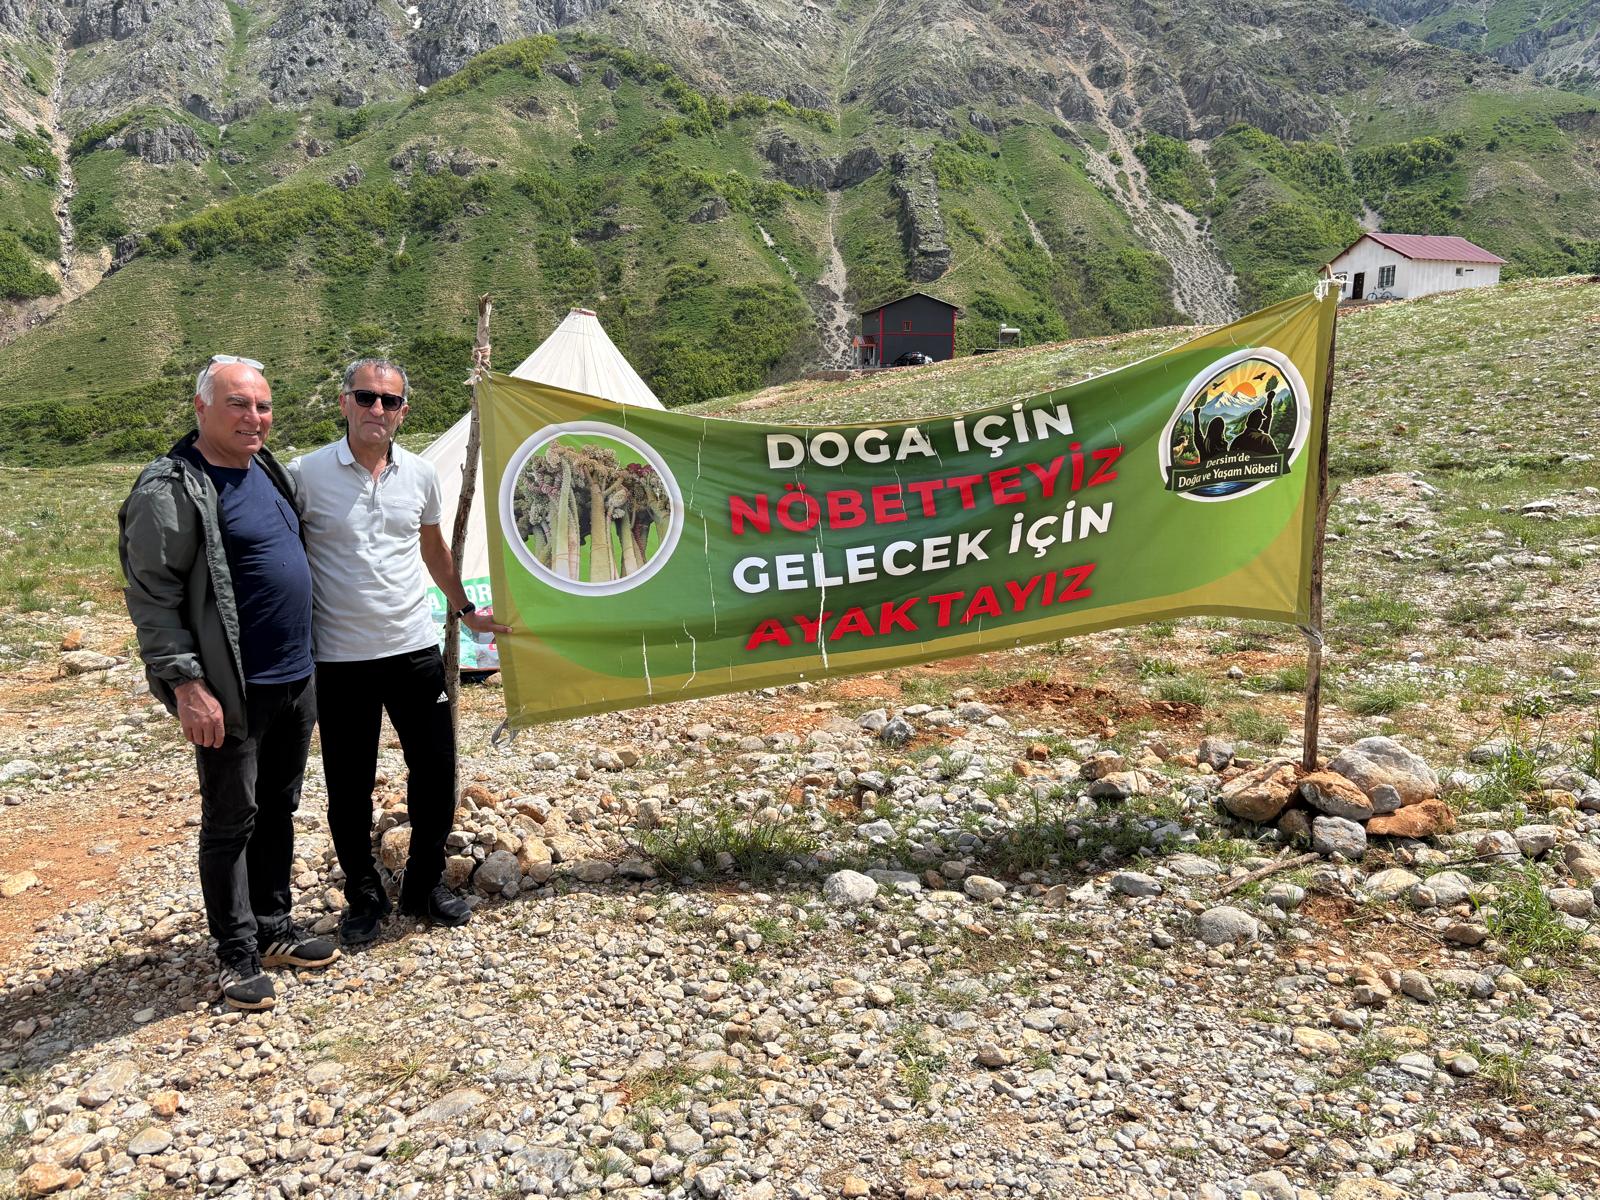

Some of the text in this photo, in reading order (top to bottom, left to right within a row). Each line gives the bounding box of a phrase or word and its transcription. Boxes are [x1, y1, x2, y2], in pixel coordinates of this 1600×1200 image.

[767, 403, 1074, 469] DOGA İÇİN
[1178, 462, 1278, 488] Doğa ve Yaşam Nöbeti
[728, 441, 1126, 535] NÖBETTEYİZ
[732, 499, 1113, 594] GELECEK İÇİN
[745, 562, 1097, 650] AYAKTAYIZ
